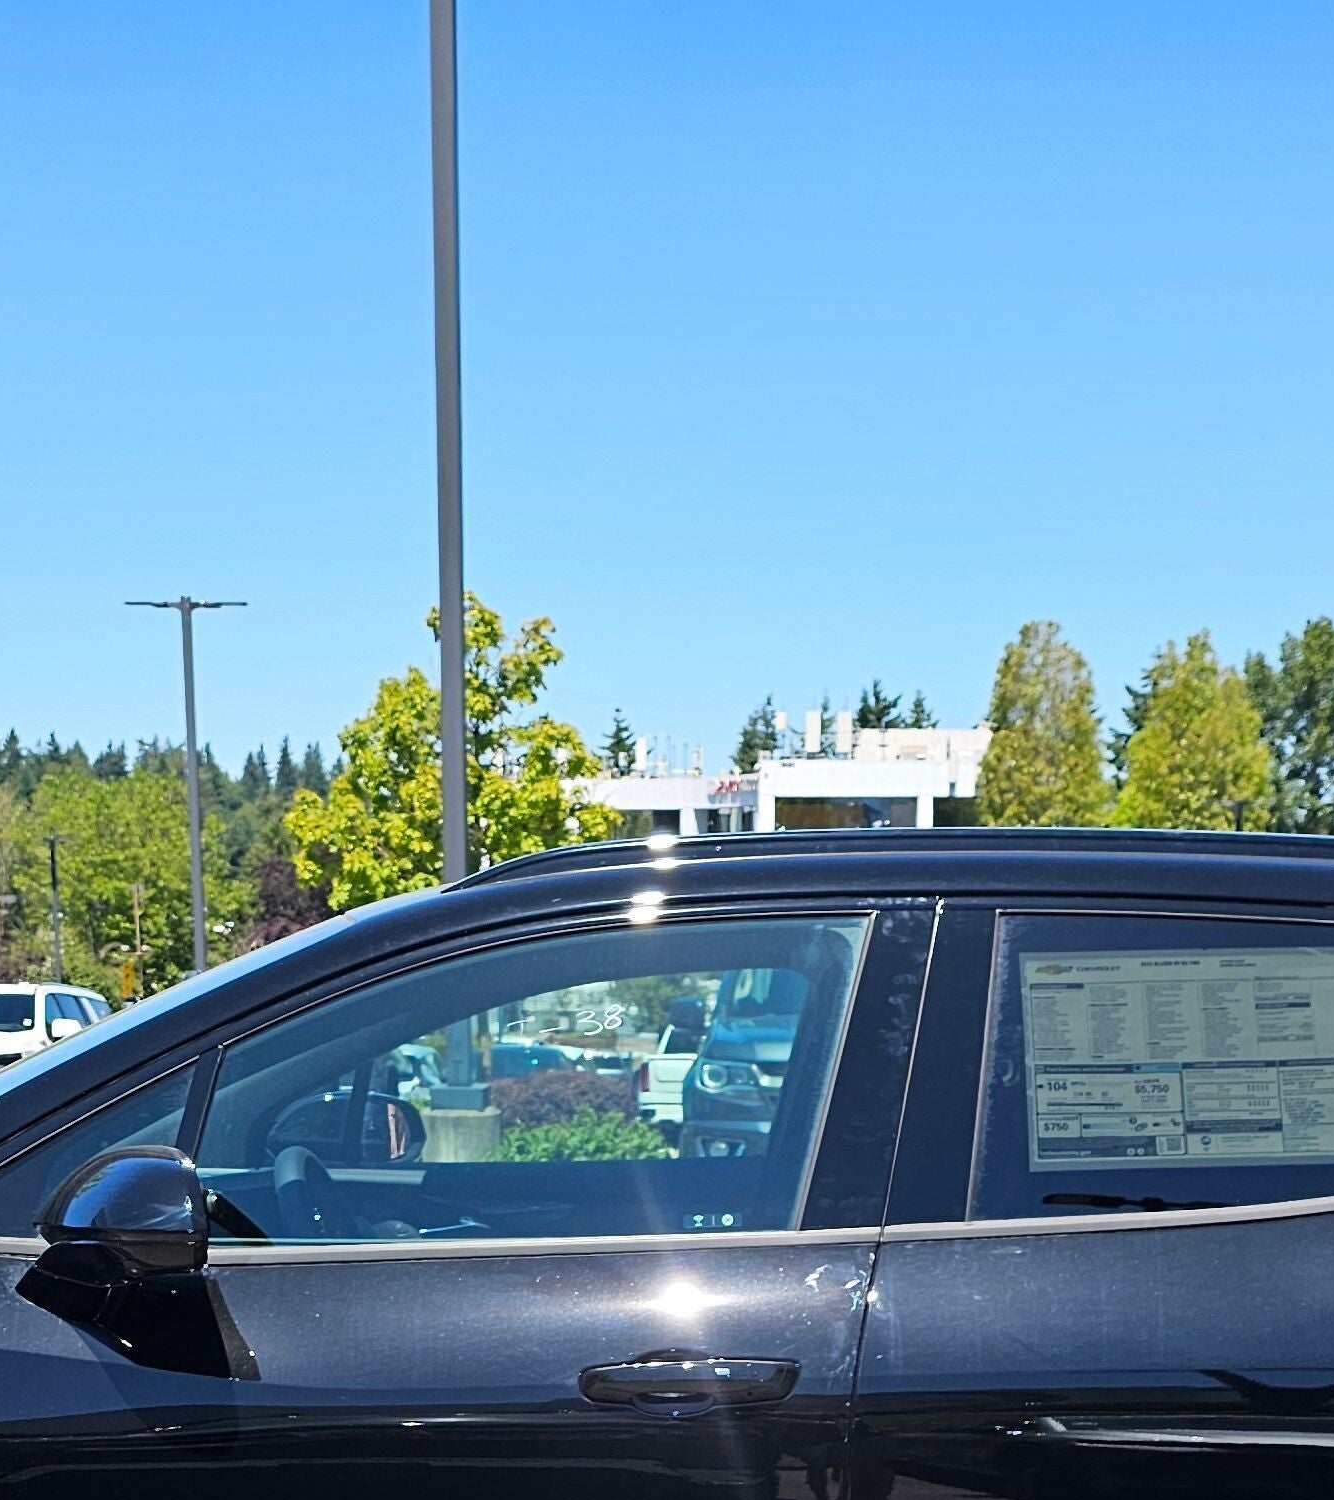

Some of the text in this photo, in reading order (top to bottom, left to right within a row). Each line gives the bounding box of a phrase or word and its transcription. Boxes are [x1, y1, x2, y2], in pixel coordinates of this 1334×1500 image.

[1047, 1081, 1067, 1091] 104
[1134, 1084, 1169, 1094] $5,750
[1044, 1122, 1068, 1131] $750
